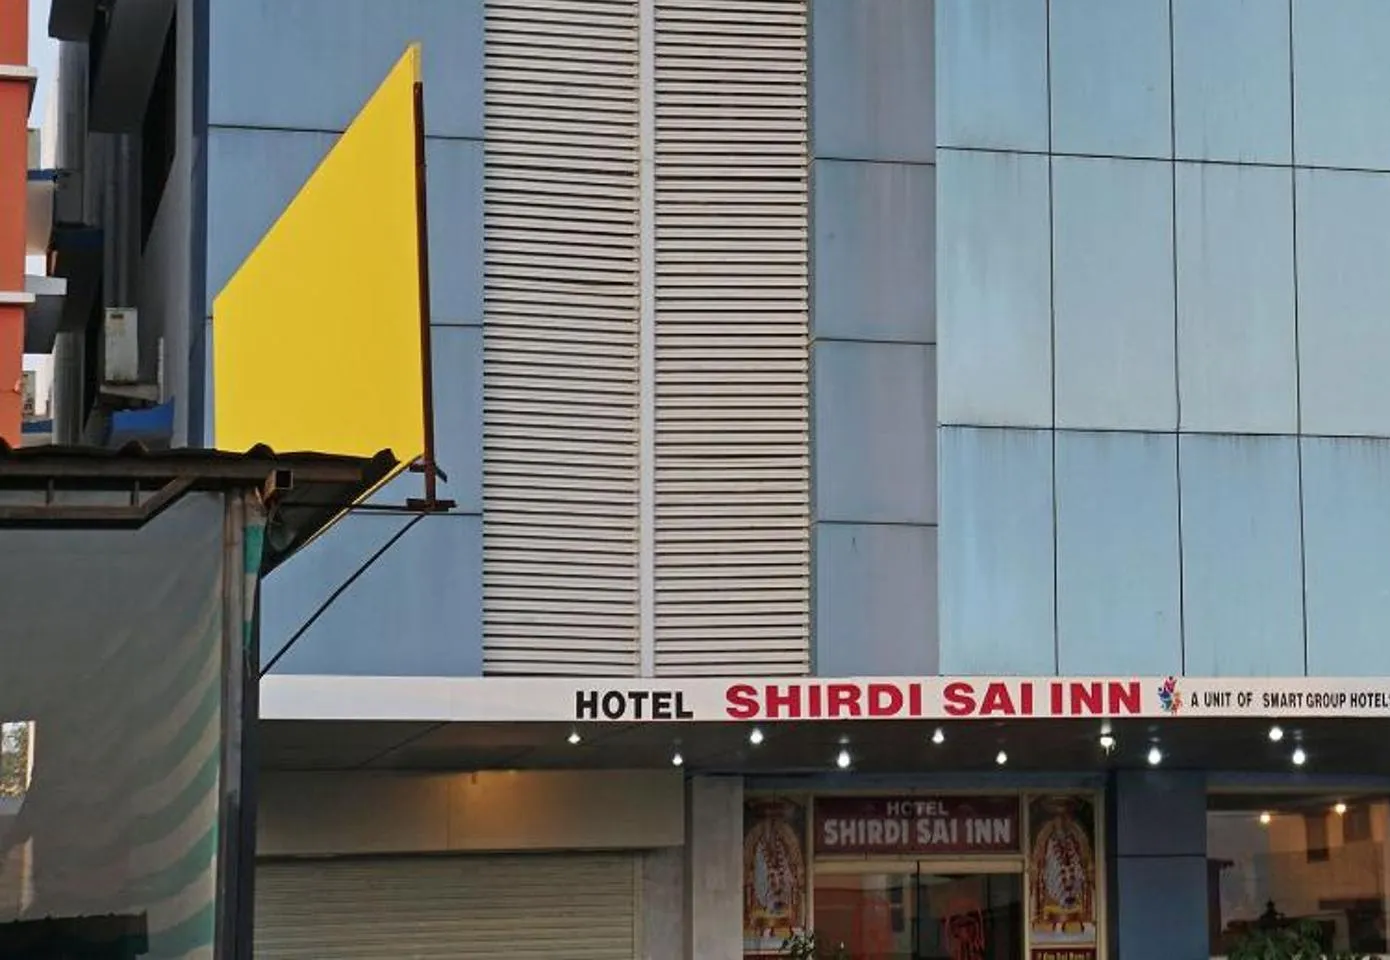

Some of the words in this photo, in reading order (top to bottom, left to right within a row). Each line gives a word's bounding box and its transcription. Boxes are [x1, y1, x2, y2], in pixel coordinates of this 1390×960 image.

[575, 690, 694, 720] HOTEL
[725, 683, 922, 719] SHIRDI
[943, 682, 1033, 716] SAI
[1050, 681, 1141, 715] INN
[1191, 692, 1199, 708] A
[1204, 692, 1232, 708] UNIT
[1237, 692, 1253, 708] OF
[1263, 692, 1303, 708] SMART
[1306, 692, 1346, 708] GROUP
[887, 801, 949, 817] HOTEL
[824, 818, 910, 846] SHIRDI
[916, 818, 958, 845] SAI
[965, 817, 1011, 845] INN
